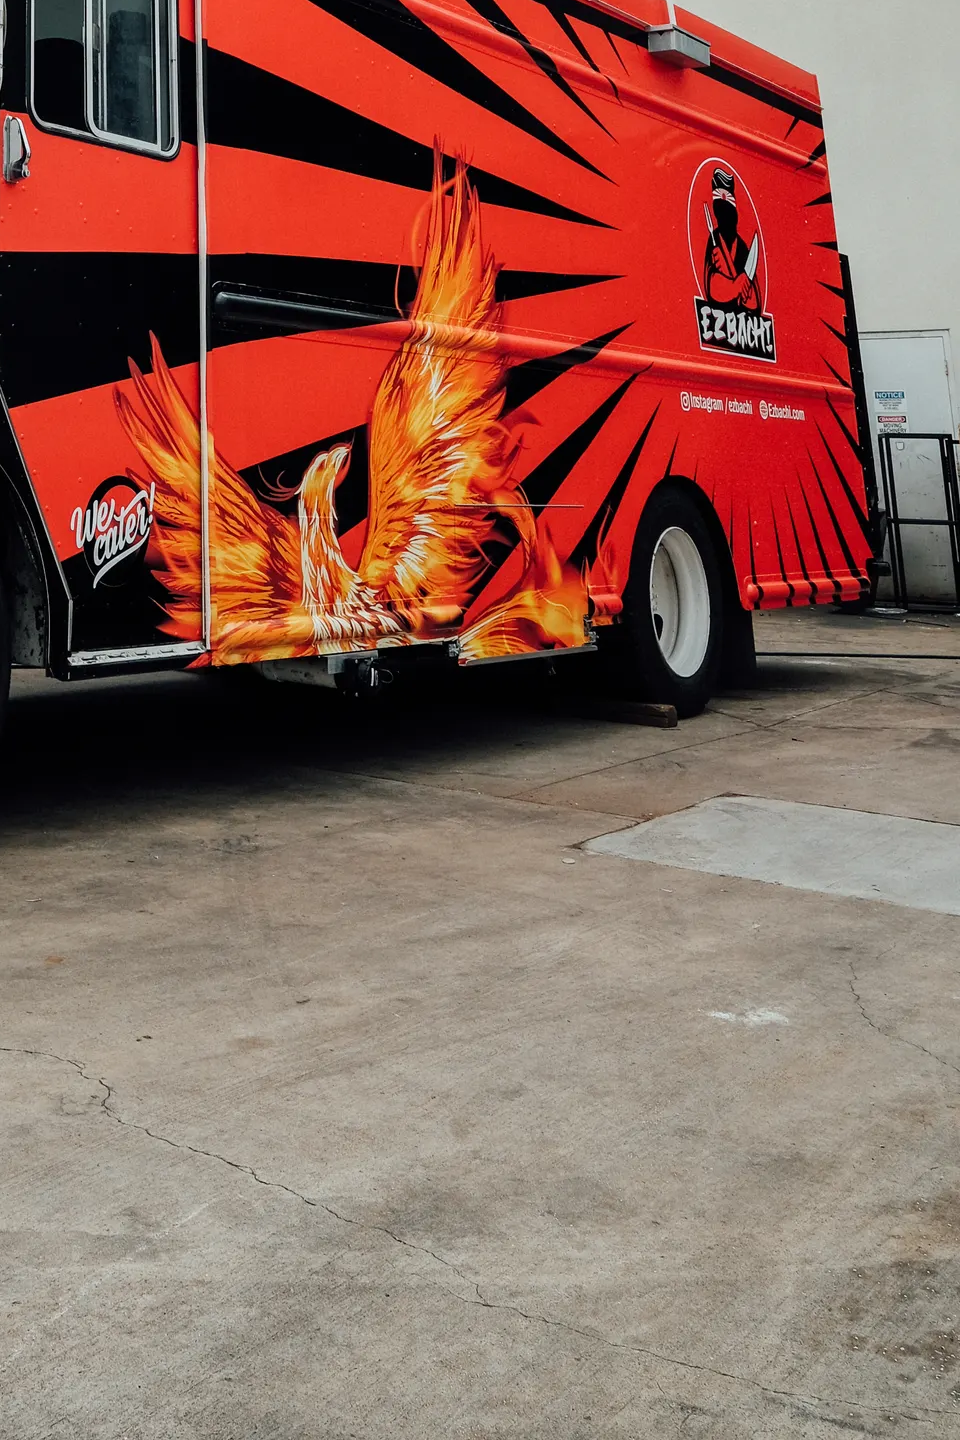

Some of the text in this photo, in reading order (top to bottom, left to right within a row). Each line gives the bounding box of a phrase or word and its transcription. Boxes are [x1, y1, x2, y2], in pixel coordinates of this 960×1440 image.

[690, 392, 724, 413] Instagram
[768, 403, 806, 421] Ezbachi.com
[70, 498, 116, 549] We
